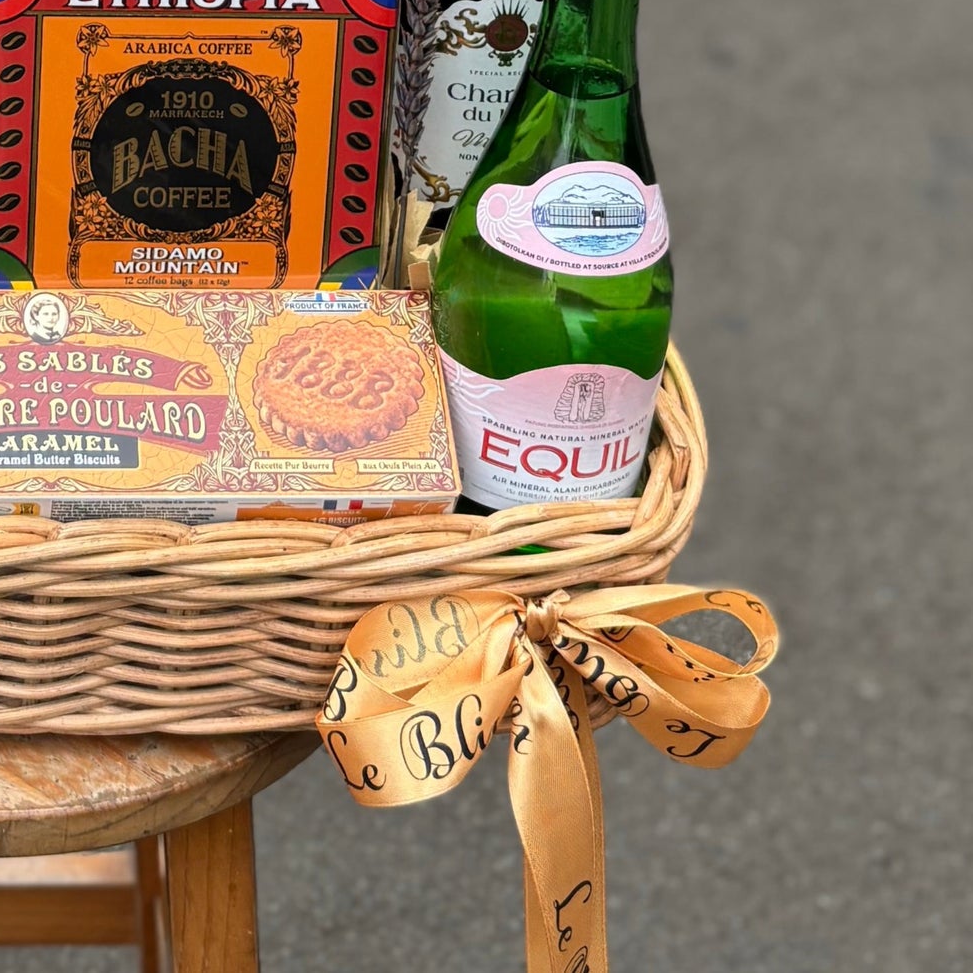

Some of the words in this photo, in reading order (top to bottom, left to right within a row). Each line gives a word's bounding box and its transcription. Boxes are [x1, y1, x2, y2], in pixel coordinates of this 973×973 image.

[123, 43, 194, 55] ARABICA
[198, 43, 253, 55] COFFEE
[160, 90, 215, 108] 1910
[447, 82, 516, 103] Char
[149, 109, 225, 119] MARRAKECH
[462, 106, 492, 122] du
[111, 126, 254, 195] BACHA
[133, 187, 232, 208] COFFEE
[132, 247, 223, 261] SIDAMO
[114, 261, 240, 275] MOUNTAIN
[550, 258, 582, 270] BOTTLED
[593, 262, 619, 270] SOURCE
[137, 277, 167, 285] coffee
[170, 277, 193, 287] bags
[284, 302, 322, 310] PRODUCT
[324, 302, 335, 310] OF
[337, 302, 369, 310] FRANCE
[17, 349, 154, 380] SABLÉS
[49, 398, 207, 441] POULARD
[481, 415, 537, 438] SPARKLING
[540, 433, 585, 442] NATURAL
[589, 428, 627, 441] MINERAL
[34, 454, 72, 466] Butter
[74, 453, 121, 466] Biscuits
[479, 428, 641, 483] EQUIL
[254, 461, 284, 470] Recette
[285, 461, 300, 470] Pur
[302, 461, 330, 470] Beurre
[363, 462, 377, 470] aux
[402, 461, 422, 470] Plein
[424, 461, 437, 470] Air
[492, 474, 507, 485] AIR
[509, 480, 551, 493] MINERAL
